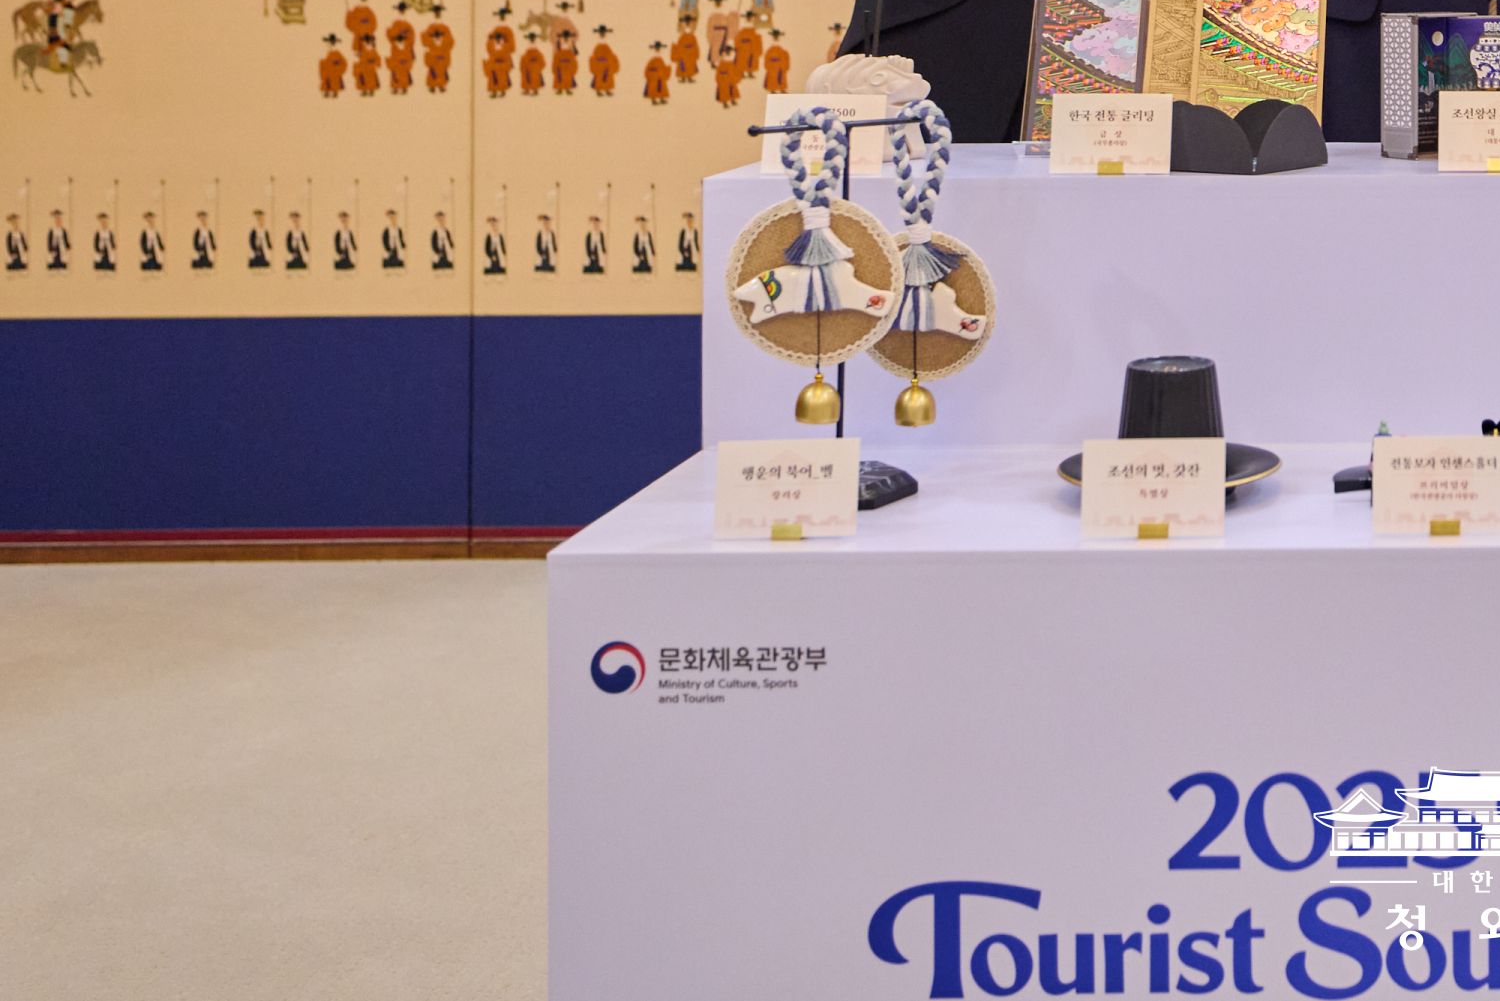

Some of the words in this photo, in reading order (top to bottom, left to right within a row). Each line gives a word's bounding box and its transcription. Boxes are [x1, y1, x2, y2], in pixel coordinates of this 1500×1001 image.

[1068, 110, 1092, 121] 한국
[1094, 110, 1116, 121] 전통
[1453, 108, 1497, 119] 조선왕실
[1439, 457, 1498, 469] 인센스홀더
[741, 466, 782, 480] 행운의
[1109, 464, 1148, 478] 조선의
[1152, 464, 1170, 477] 멋,
[1173, 464, 1200, 477] 갓잔
[659, 647, 826, 672] 문화체육관광부
[659, 680, 701, 690] Ministry
[704, 679, 715, 689] of
[718, 679, 760, 689] Culture,
[763, 679, 798, 689] Sports
[658, 695, 679, 704] and
[683, 693, 725, 703] Tourism
[869, 882, 1264, 998] Tourist
